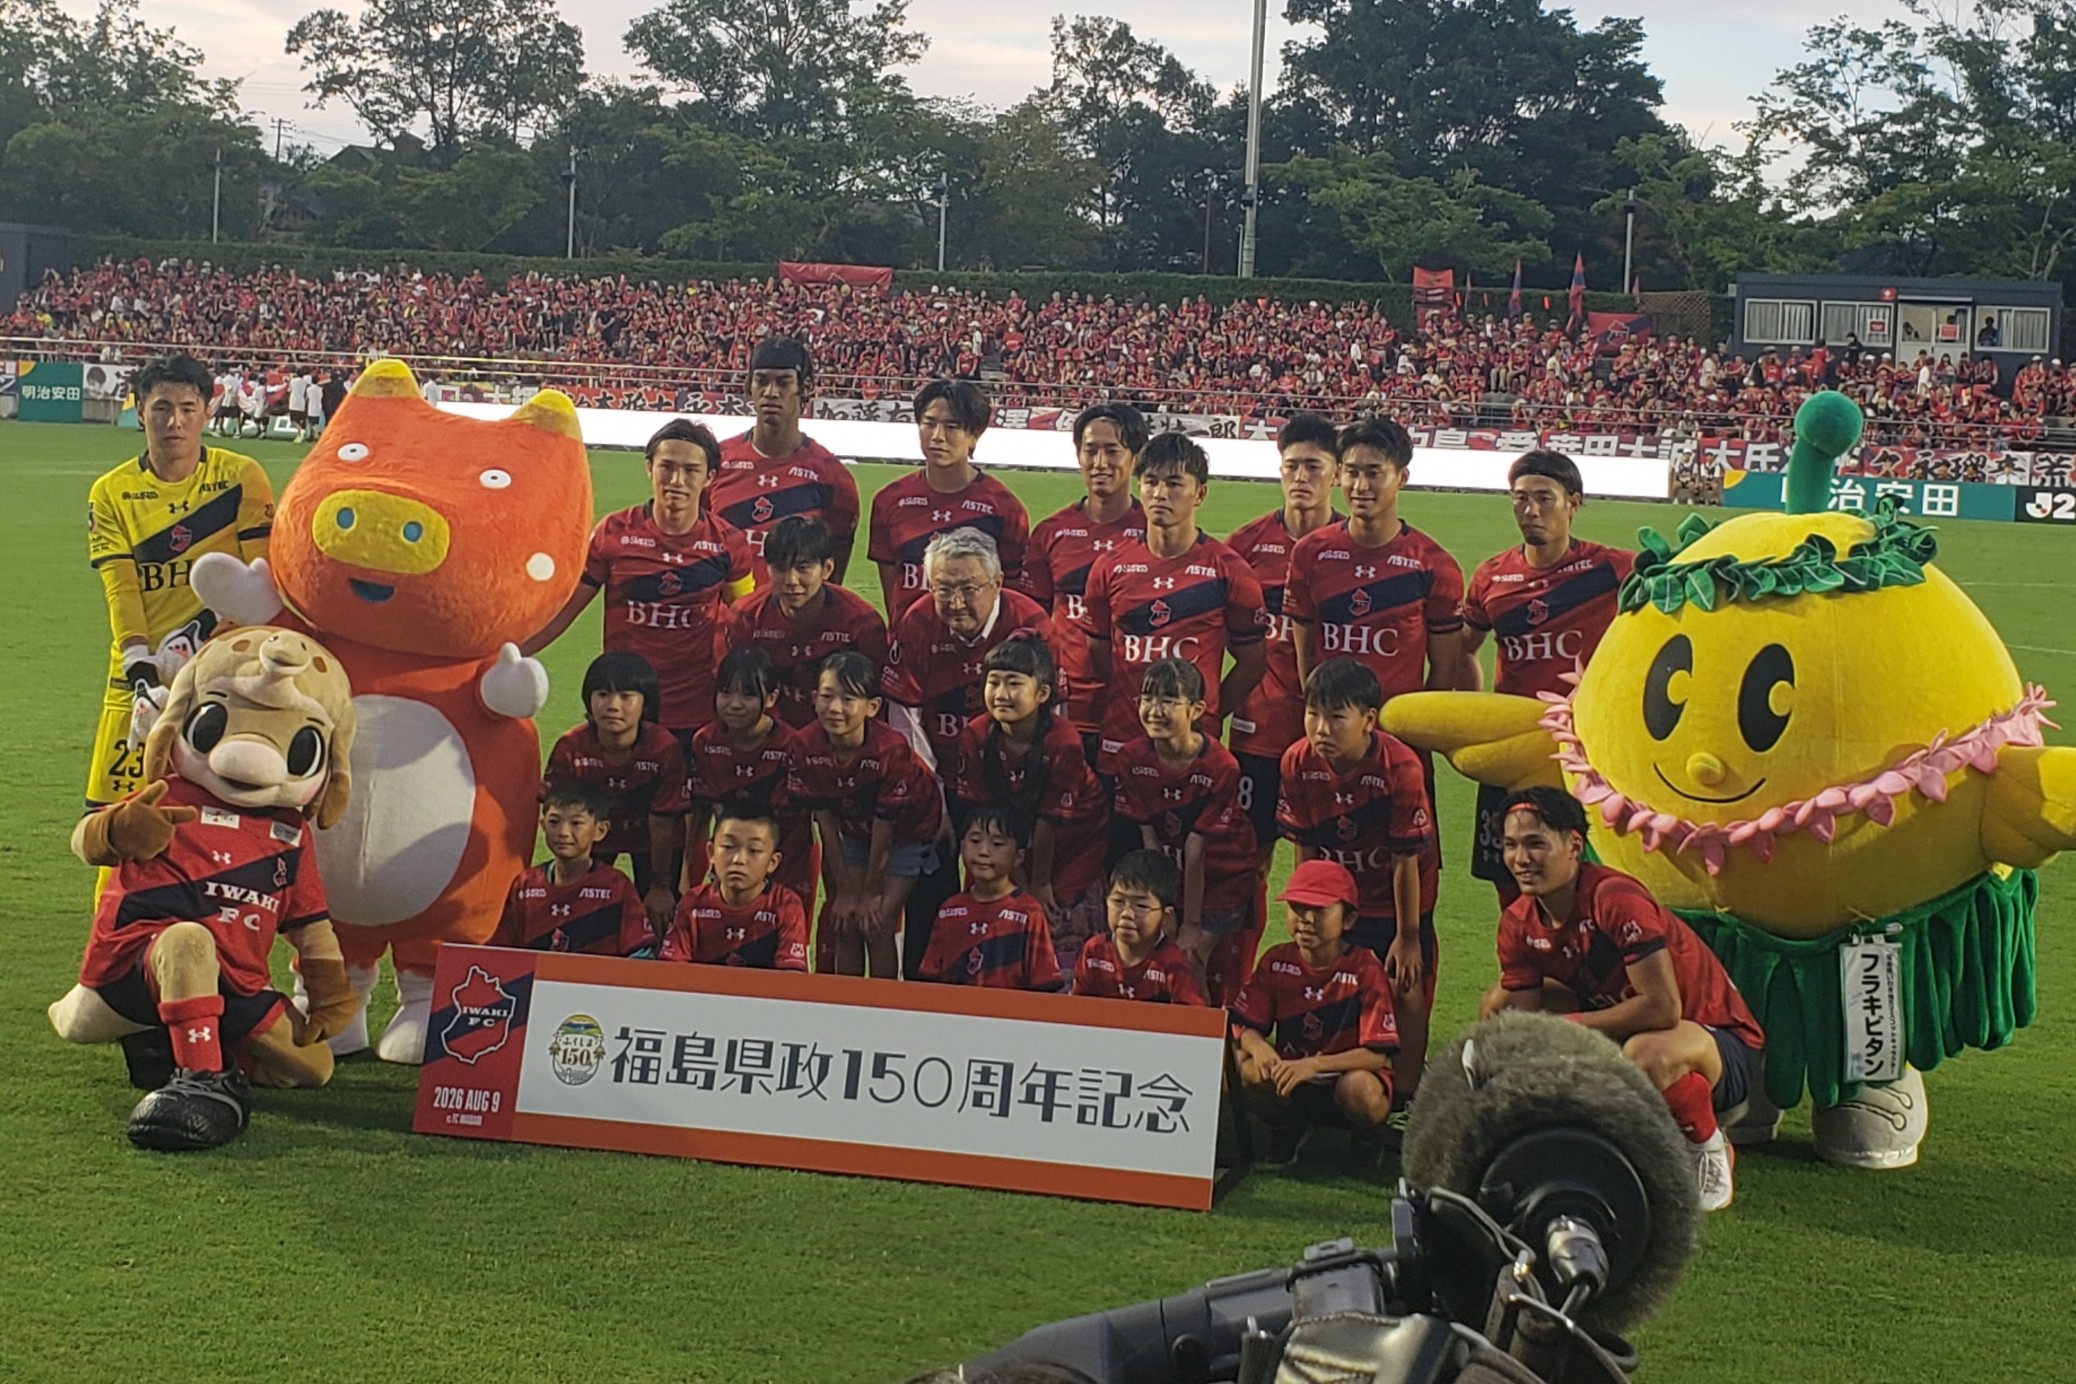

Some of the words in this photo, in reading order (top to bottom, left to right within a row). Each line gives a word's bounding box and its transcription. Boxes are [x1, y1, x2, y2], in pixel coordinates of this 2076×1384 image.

[22, 385, 80, 400] 明治安田
[961, 499, 994, 515] ASTEC
[1781, 477, 1959, 517] 治安田
[141, 559, 191, 592] BH
[903, 562, 929, 590] B
[1387, 554, 1421, 569] ASTEC
[1265, 613, 1294, 642] BH
[1322, 622, 1399, 657] BHC
[1124, 634, 1199, 664] BHC
[1502, 630, 1583, 662] BHC
[108, 738, 144, 778] 23
[204, 880, 280, 913] IWAKI
[217, 905, 261, 931] FC
[462, 1006, 508, 1017] IWAKI
[467, 1017, 496, 1027] FC
[1861, 953, 1884, 1076] フラキビタン
[560, 1048, 593, 1067] 150
[610, 1026, 1193, 1134] 福島県政150周年記念
[433, 1086, 464, 1109] 2026
[464, 1089, 489, 1112] AUG
[490, 1092, 501, 1113] 9
